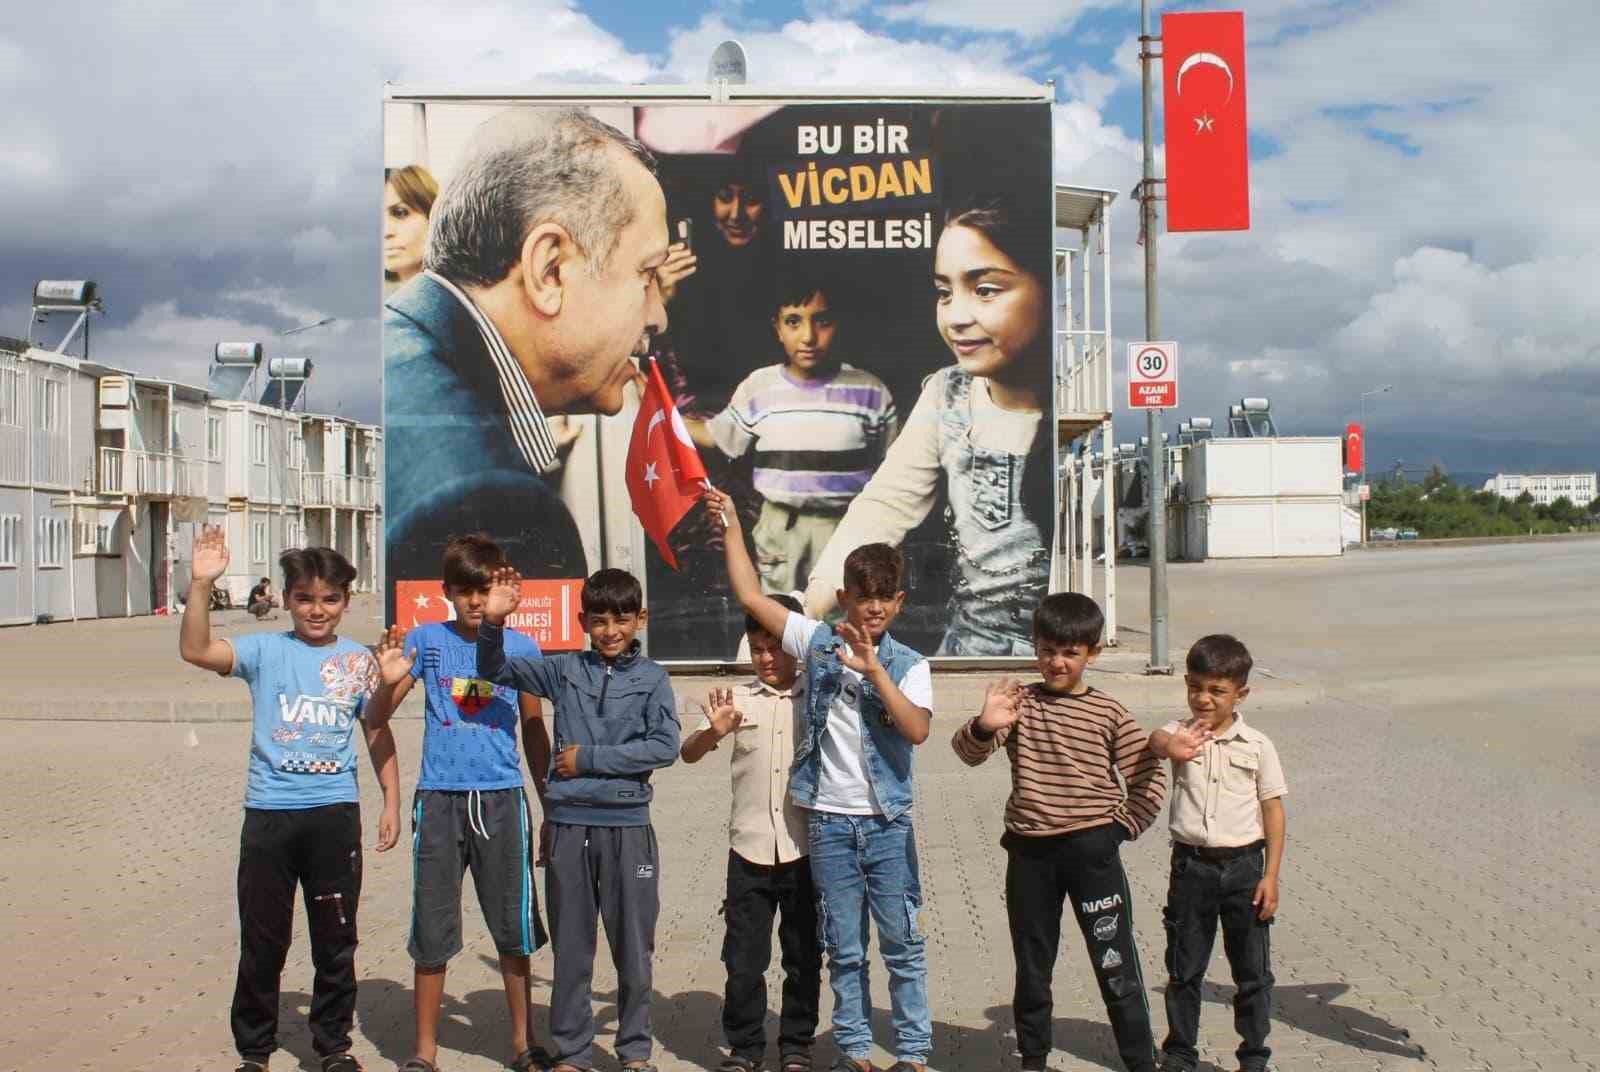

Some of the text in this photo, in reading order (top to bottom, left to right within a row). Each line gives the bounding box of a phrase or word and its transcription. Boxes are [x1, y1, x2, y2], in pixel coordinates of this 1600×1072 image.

[798, 118, 910, 154] BU BİR
[778, 159, 932, 208] VİCDAN
[783, 212, 932, 249] MESELESİ
[1143, 356, 1162, 370] 30
[1138, 384, 1169, 394] AZAMİ
[279, 694, 352, 727] VANS
[1082, 894, 1122, 913] NASA
